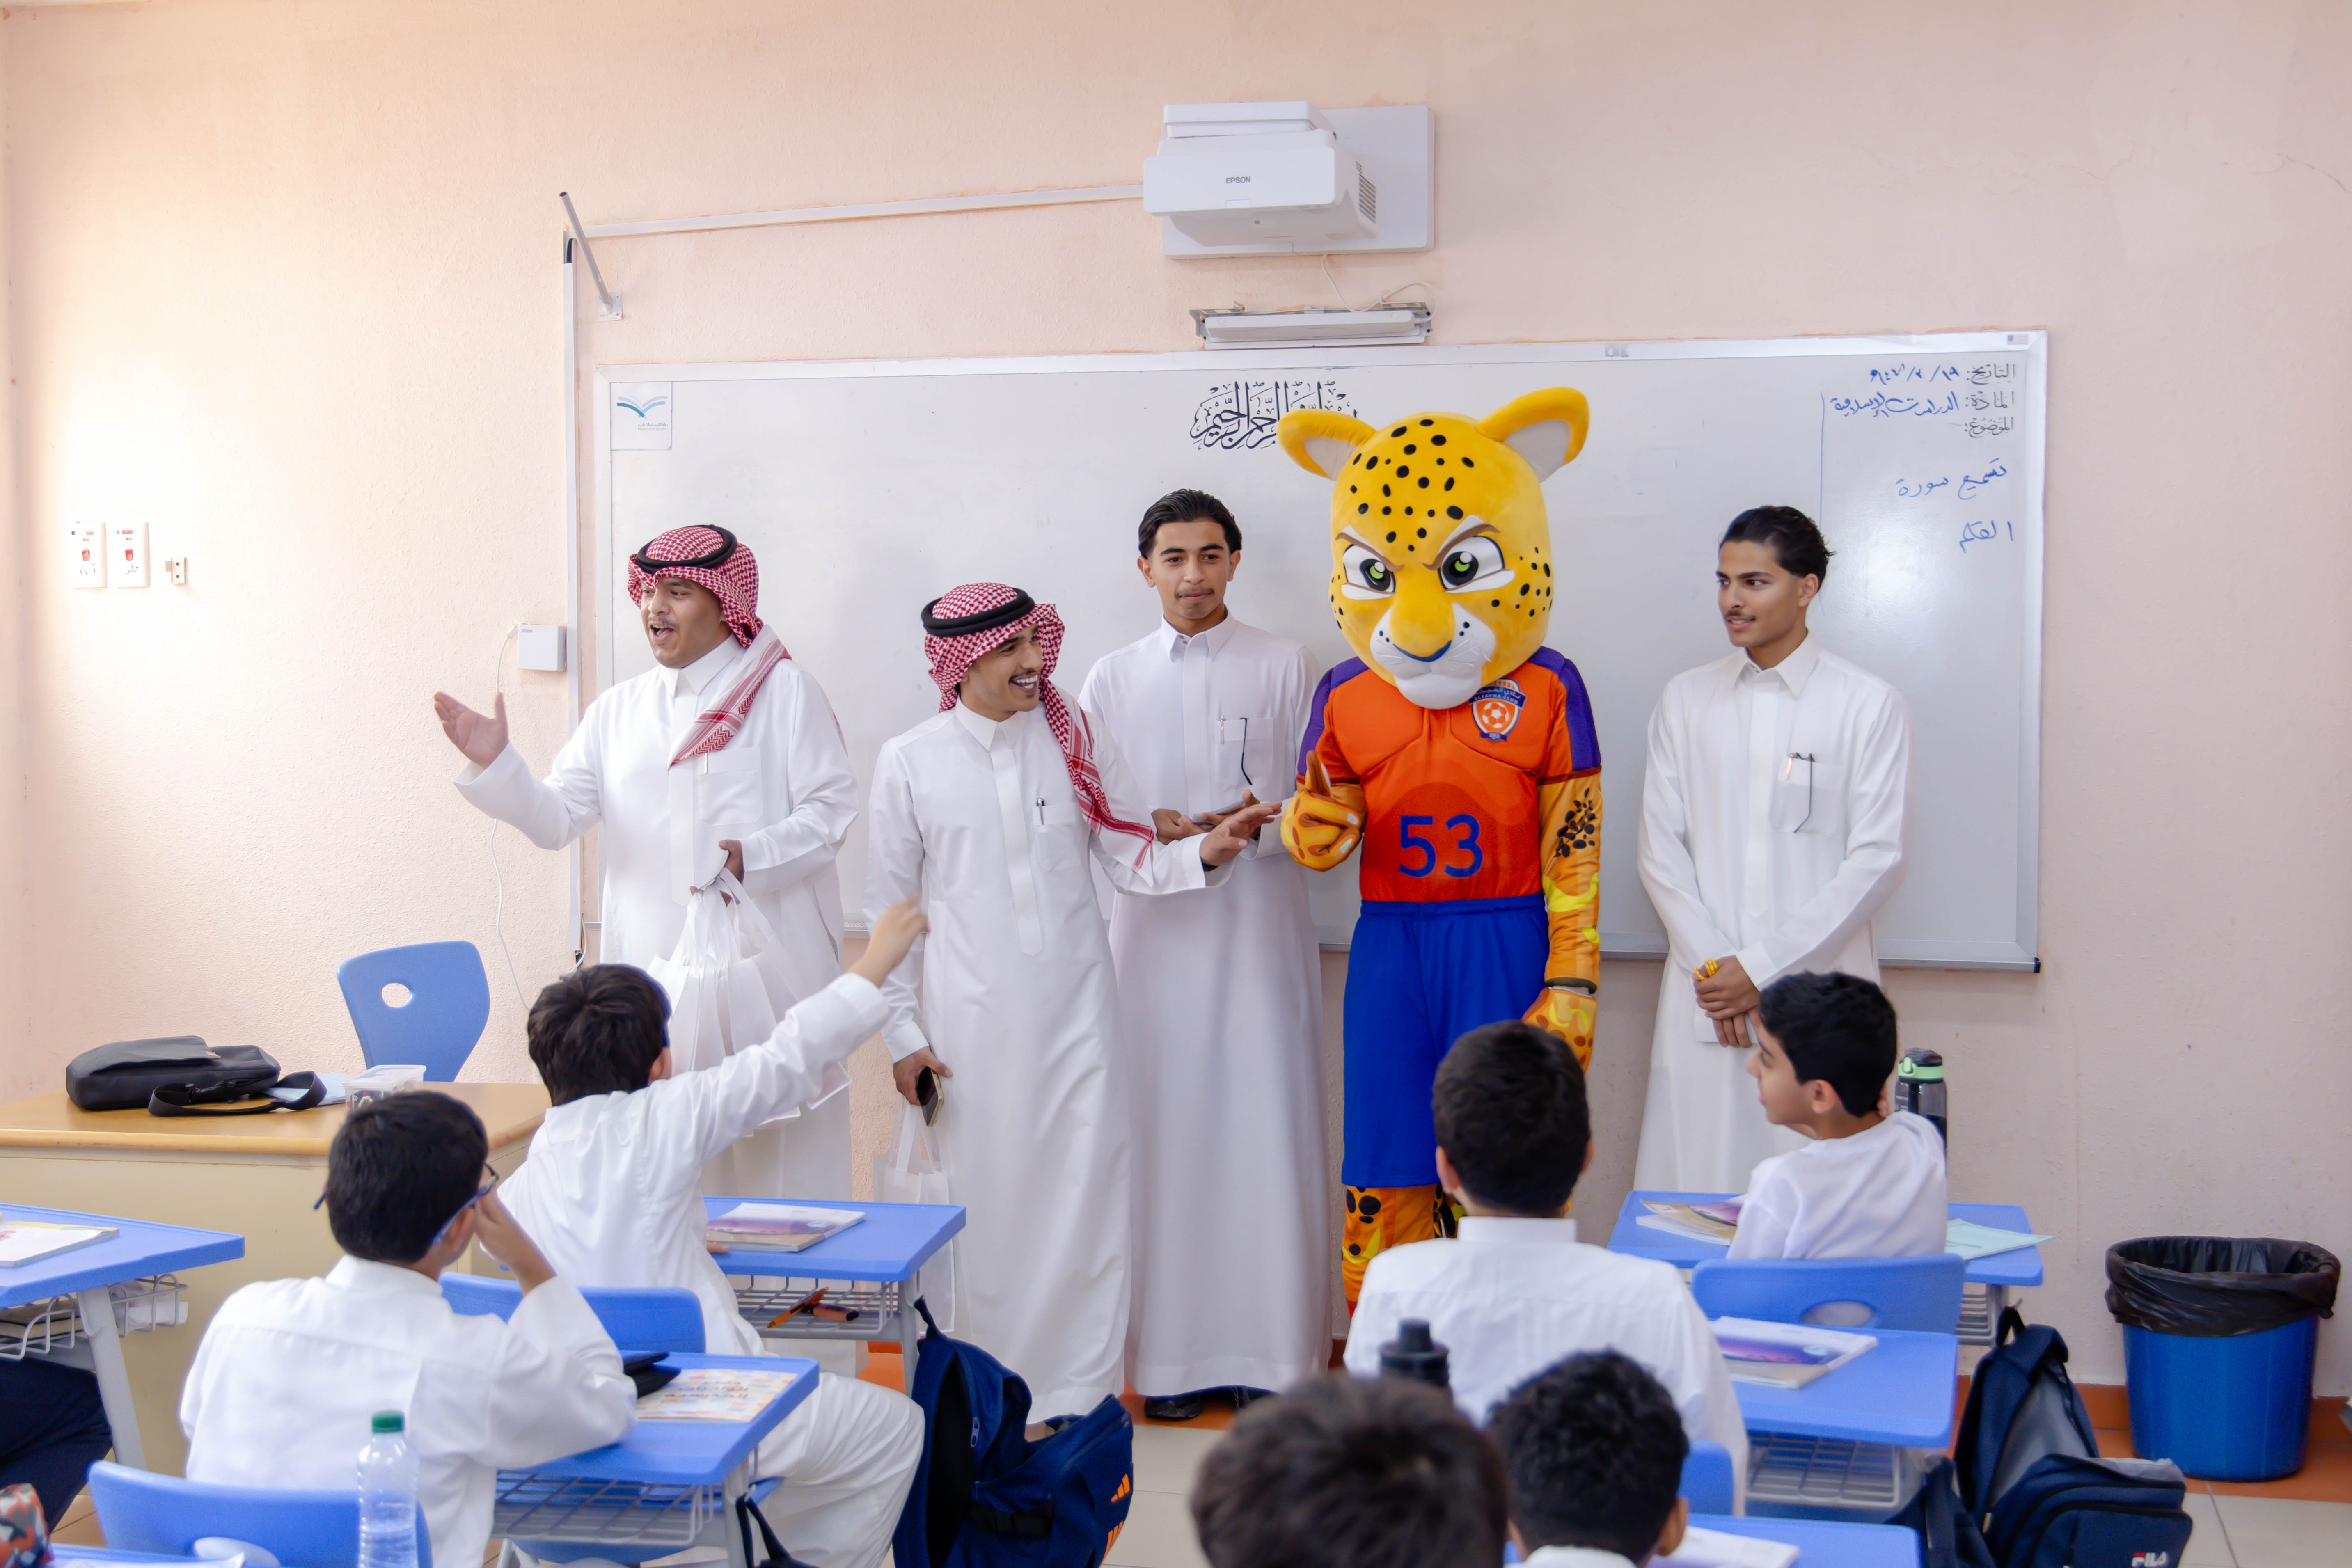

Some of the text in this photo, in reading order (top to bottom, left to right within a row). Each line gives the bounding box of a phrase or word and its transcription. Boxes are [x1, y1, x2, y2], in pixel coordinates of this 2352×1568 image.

[1895, 477, 1949, 497] سورة
[1503, 695, 1518, 705] CLUB
[1398, 813, 1483, 878] 53
[2131, 1551, 2167, 1567] FILA
